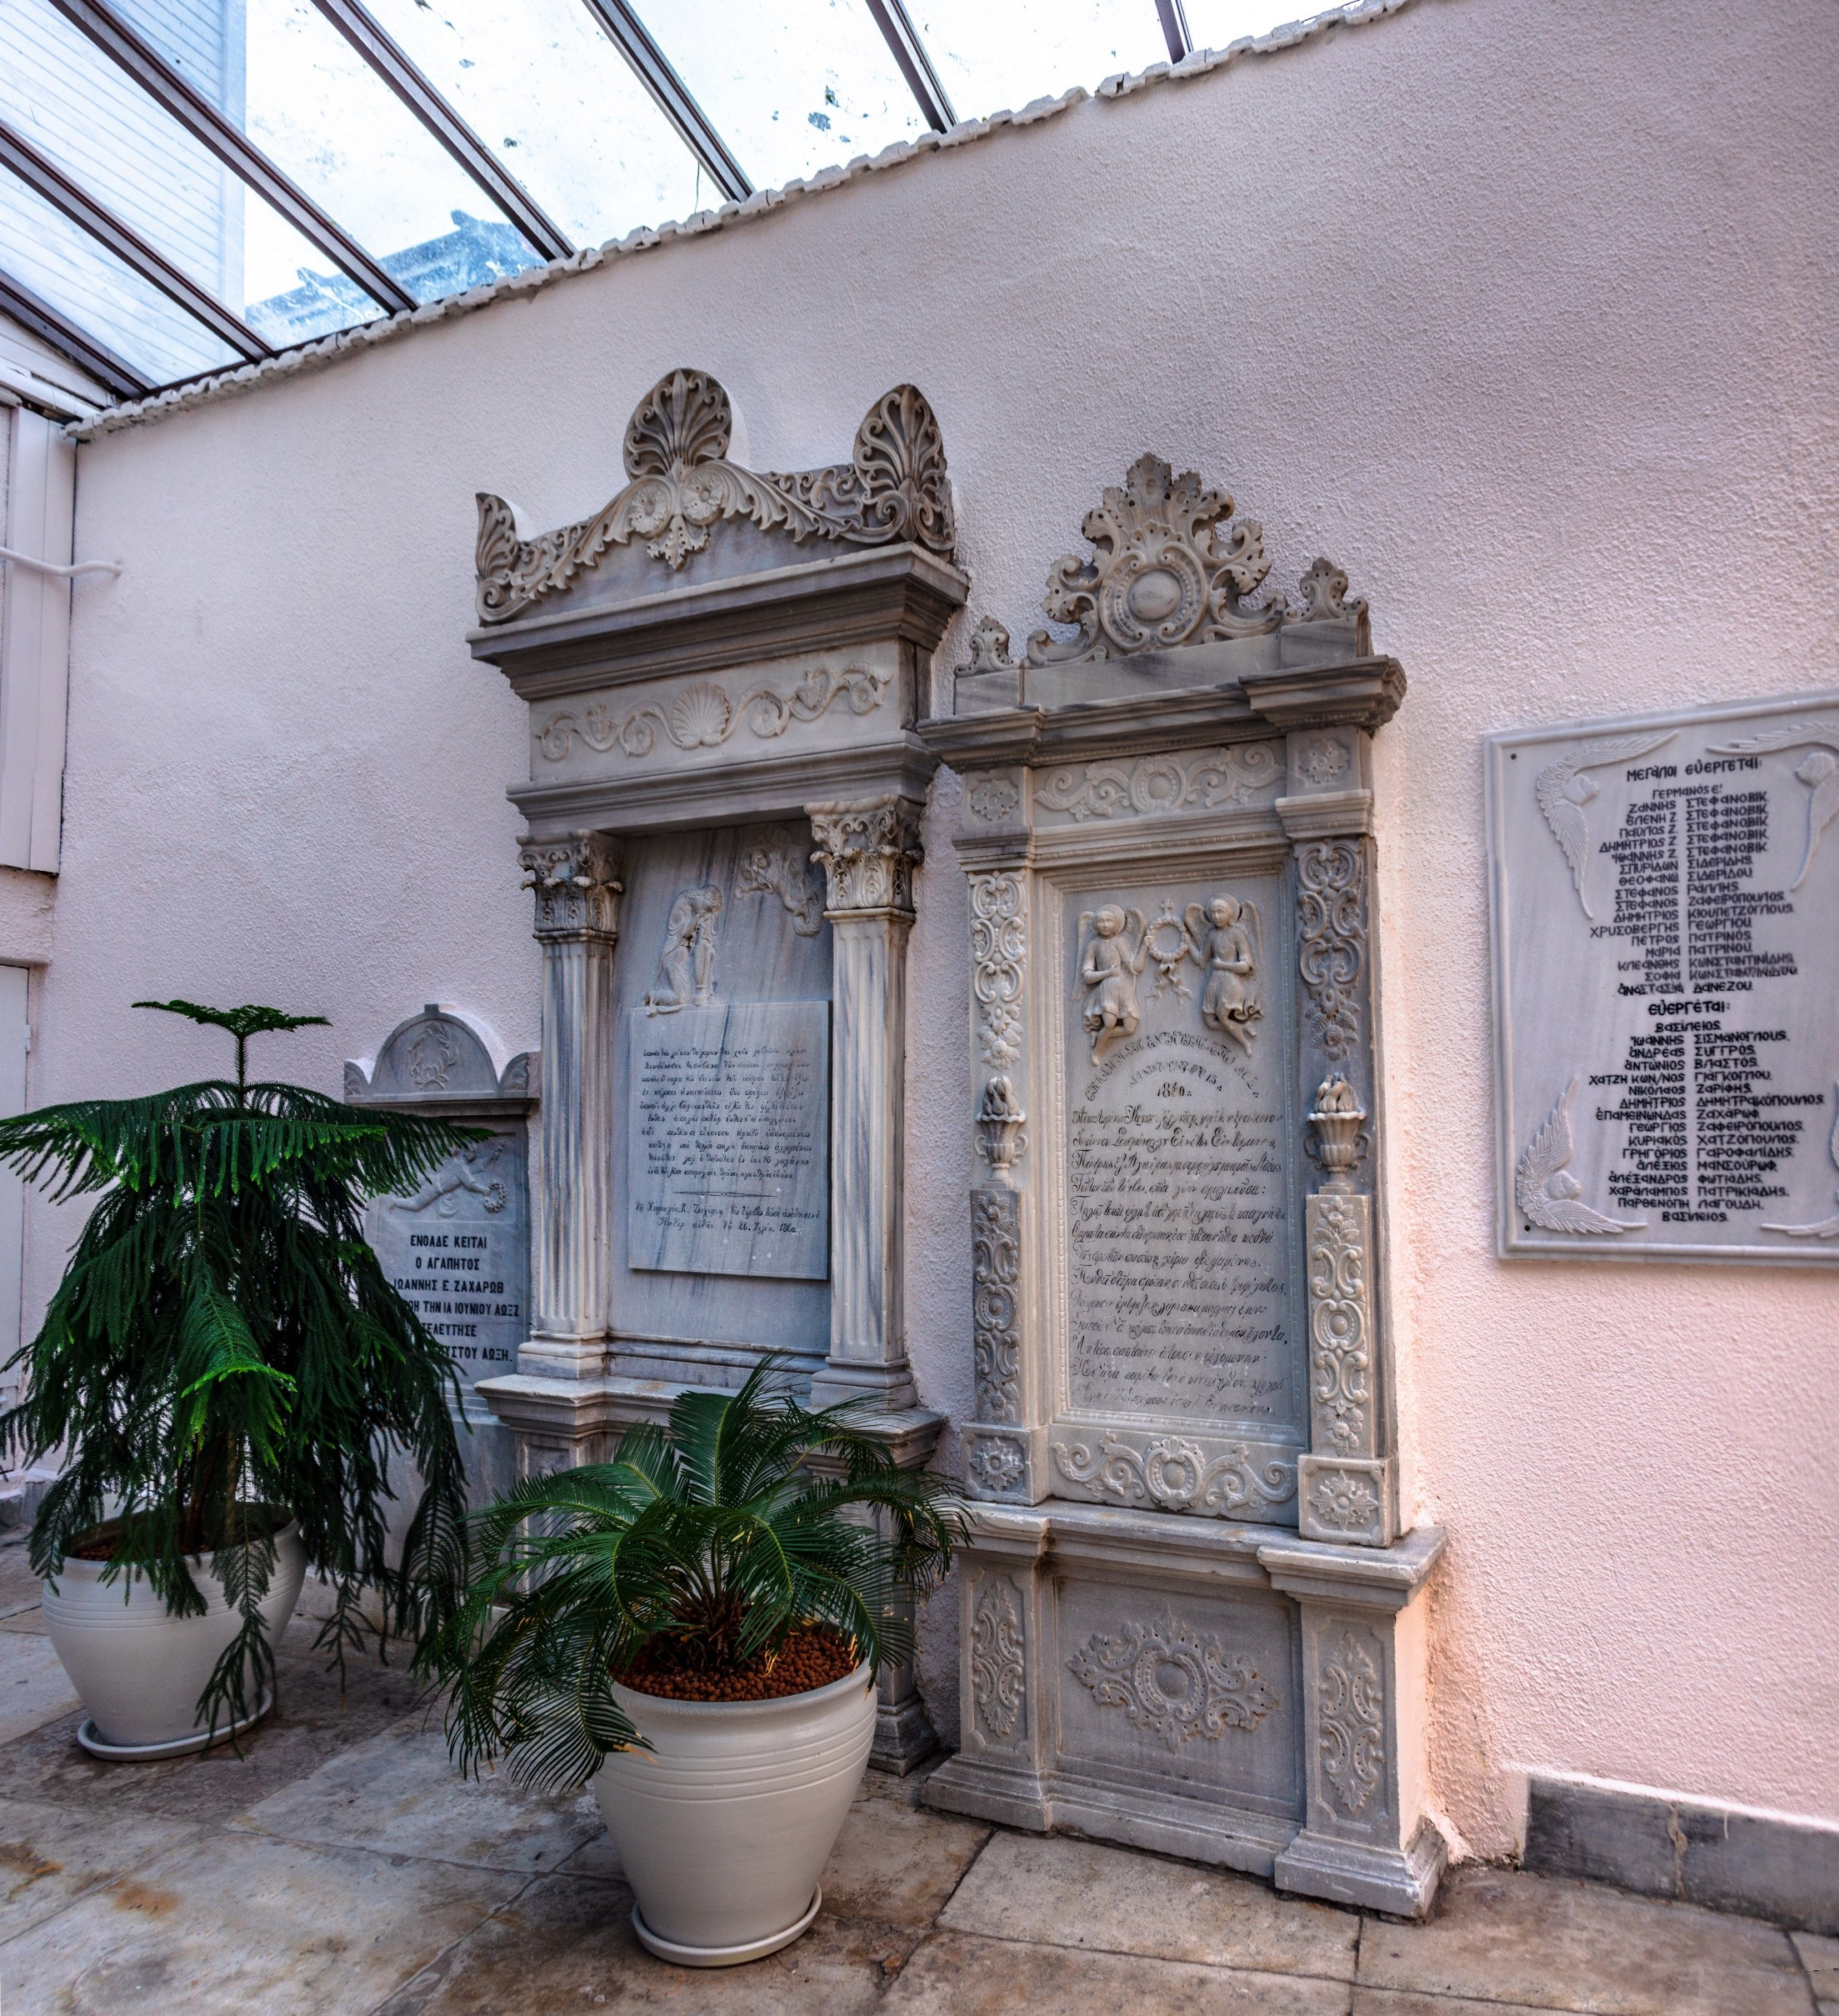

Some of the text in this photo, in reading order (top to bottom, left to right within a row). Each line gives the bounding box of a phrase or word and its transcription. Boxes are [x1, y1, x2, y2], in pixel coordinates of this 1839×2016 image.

[410, 1235, 487, 1248] ΕΝΘΑΔΕ ΚΕΙΤΑΙ
[416, 1258, 479, 1270] Ο ΑΓΑΠΗΤΟΣ
[423, 1301, 442, 1313] ΤΗΝ
[455, 1303, 491, 1315] ΙΟΥΝΙΟΥ
[422, 1323, 477, 1337] ΤΕΛΕΥΤΗΣΕ
